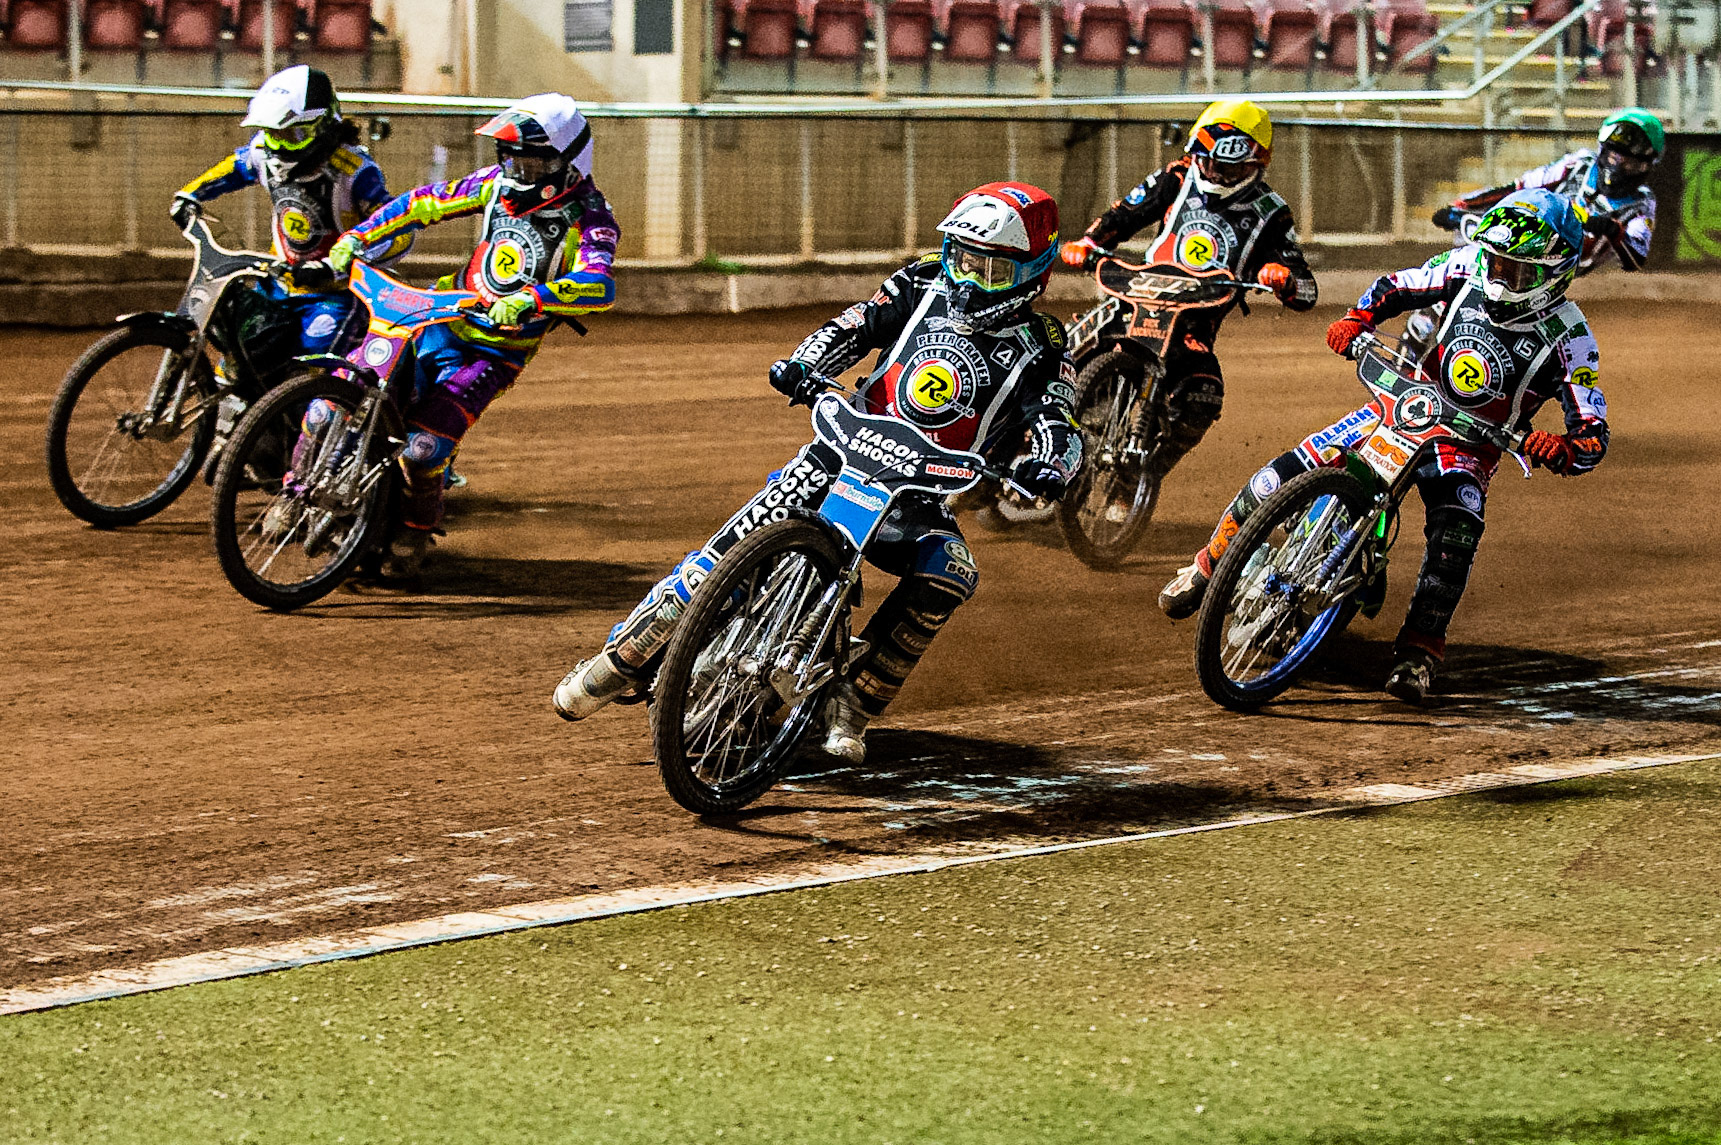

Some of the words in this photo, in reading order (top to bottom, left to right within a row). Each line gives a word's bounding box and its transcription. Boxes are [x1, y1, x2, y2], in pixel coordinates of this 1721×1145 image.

[944, 220, 990, 238] BOLL
[1240, 217, 1252, 230] 6
[916, 332, 958, 348] PETER
[956, 337, 991, 387] CRAVEN
[996, 348, 1014, 366] 4
[1452, 340, 1474, 353] BELLE
[1477, 343, 1492, 360] VUE
[1490, 362, 1500, 384] ACES
[1455, 323, 1485, 339] PETER
[1484, 332, 1515, 375] CRAVEN
[1515, 338, 1536, 358] 15
[913, 350, 942, 366] BELLE
[945, 351, 964, 369] VUE
[960, 371, 972, 397] ACES
[848, 438, 918, 478] SHOCKS
[855, 426, 924, 465] HAGON
[1363, 450, 1398, 474] FILTRATION
[927, 465, 974, 478] MOLDOW
[733, 459, 814, 541] HAGON
[754, 469, 828, 531] OCKS
